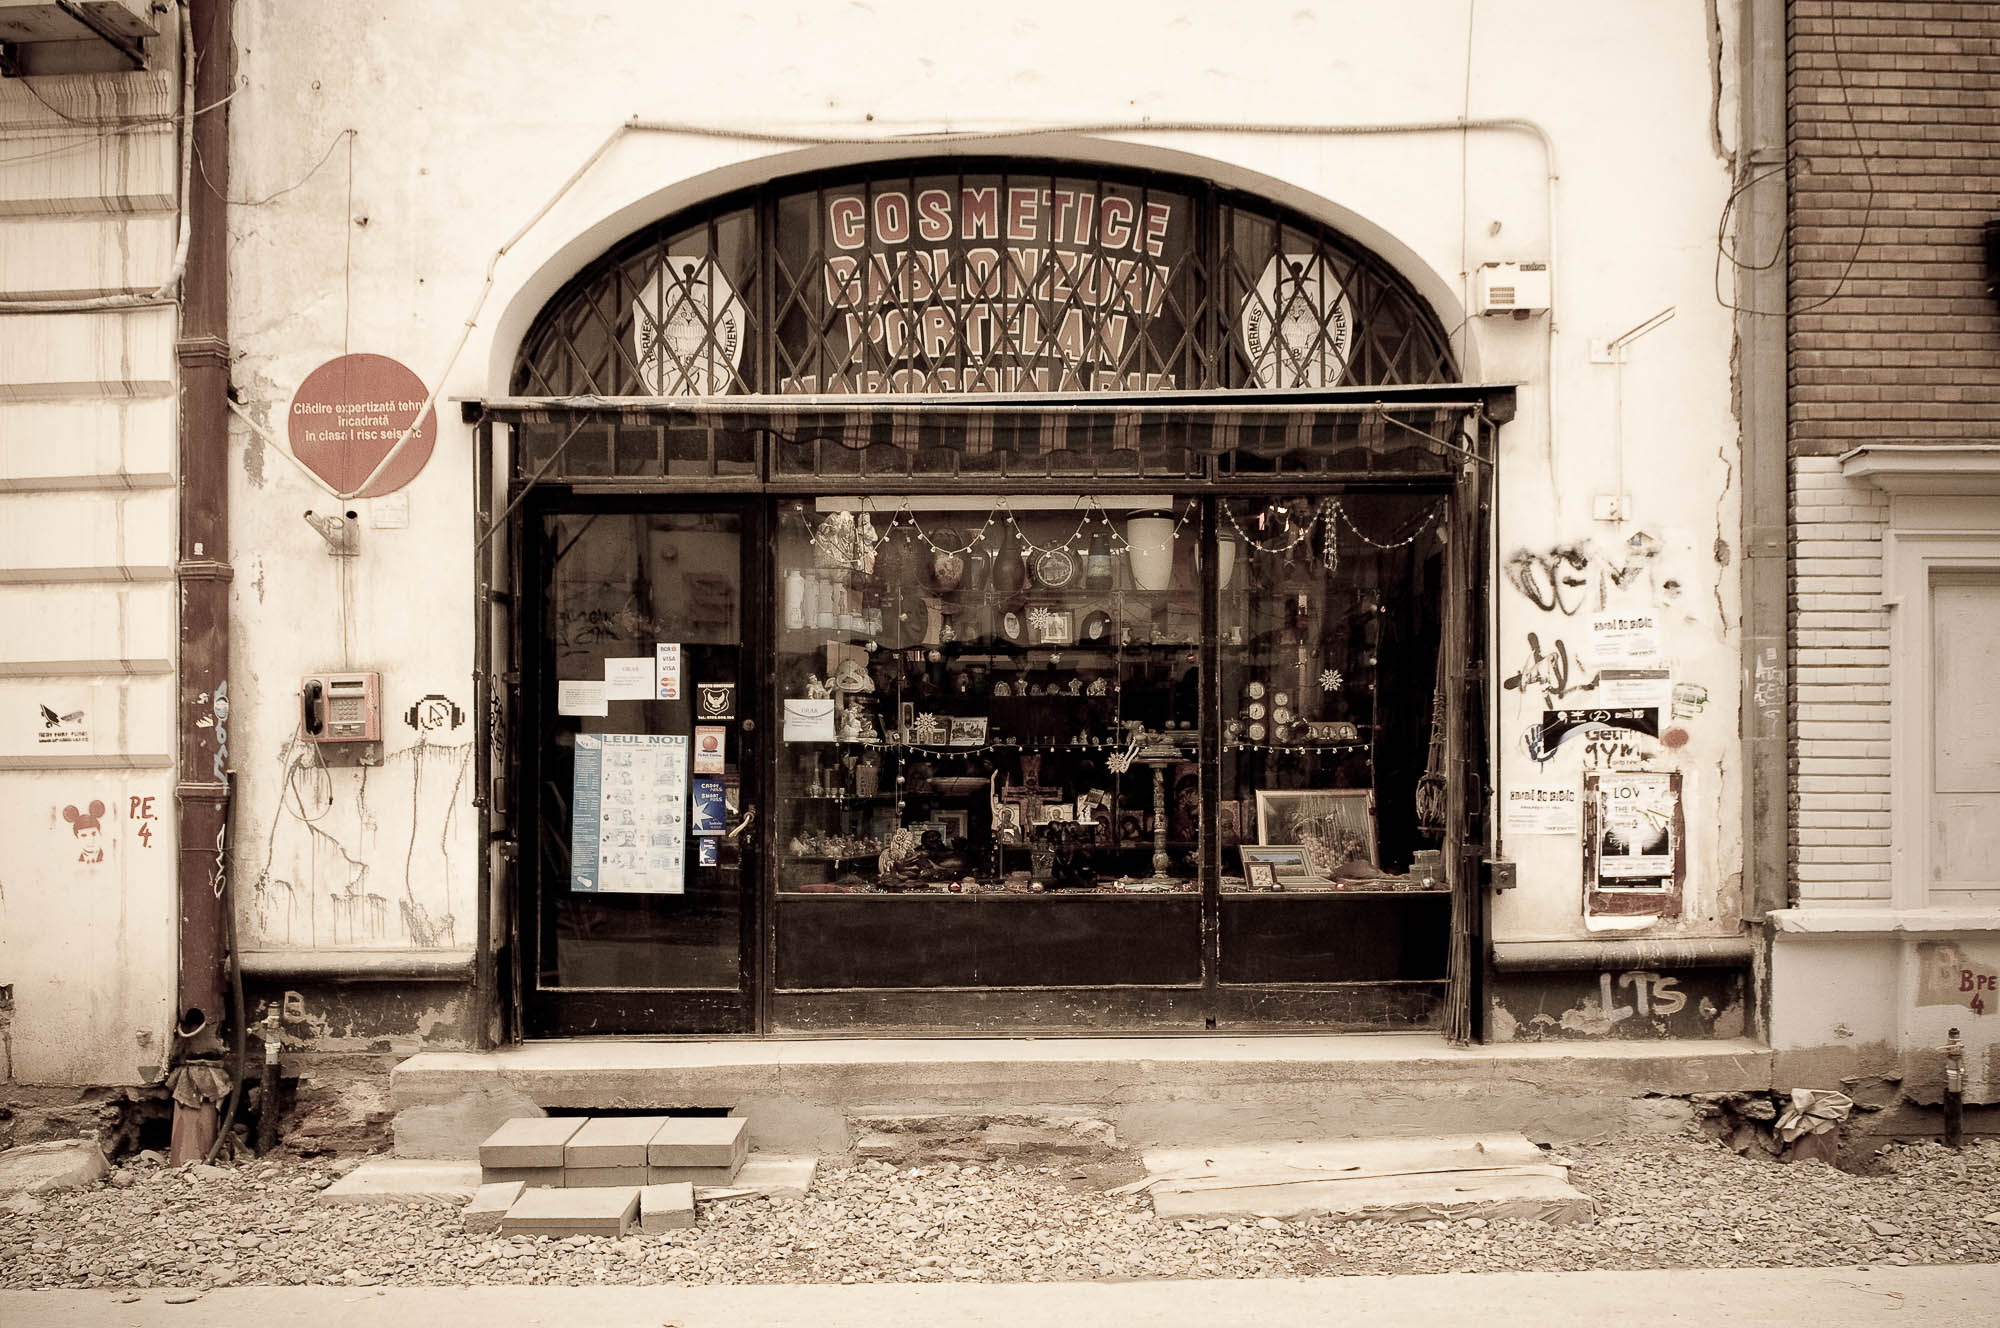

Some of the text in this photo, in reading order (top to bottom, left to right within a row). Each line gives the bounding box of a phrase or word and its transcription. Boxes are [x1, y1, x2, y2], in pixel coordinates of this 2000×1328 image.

[830, 187, 1171, 257] COSMETICE
[824, 247, 1170, 317] GABLONZURI
[1248, 307, 1263, 355] HERMES
[293, 402, 333, 415] Clădire
[335, 401, 396, 416] expertizată
[338, 414, 390, 427] încadrată
[318, 430, 348, 441] clasa
[356, 429, 378, 441] risc
[603, 735, 686, 745] LEUL NOU
